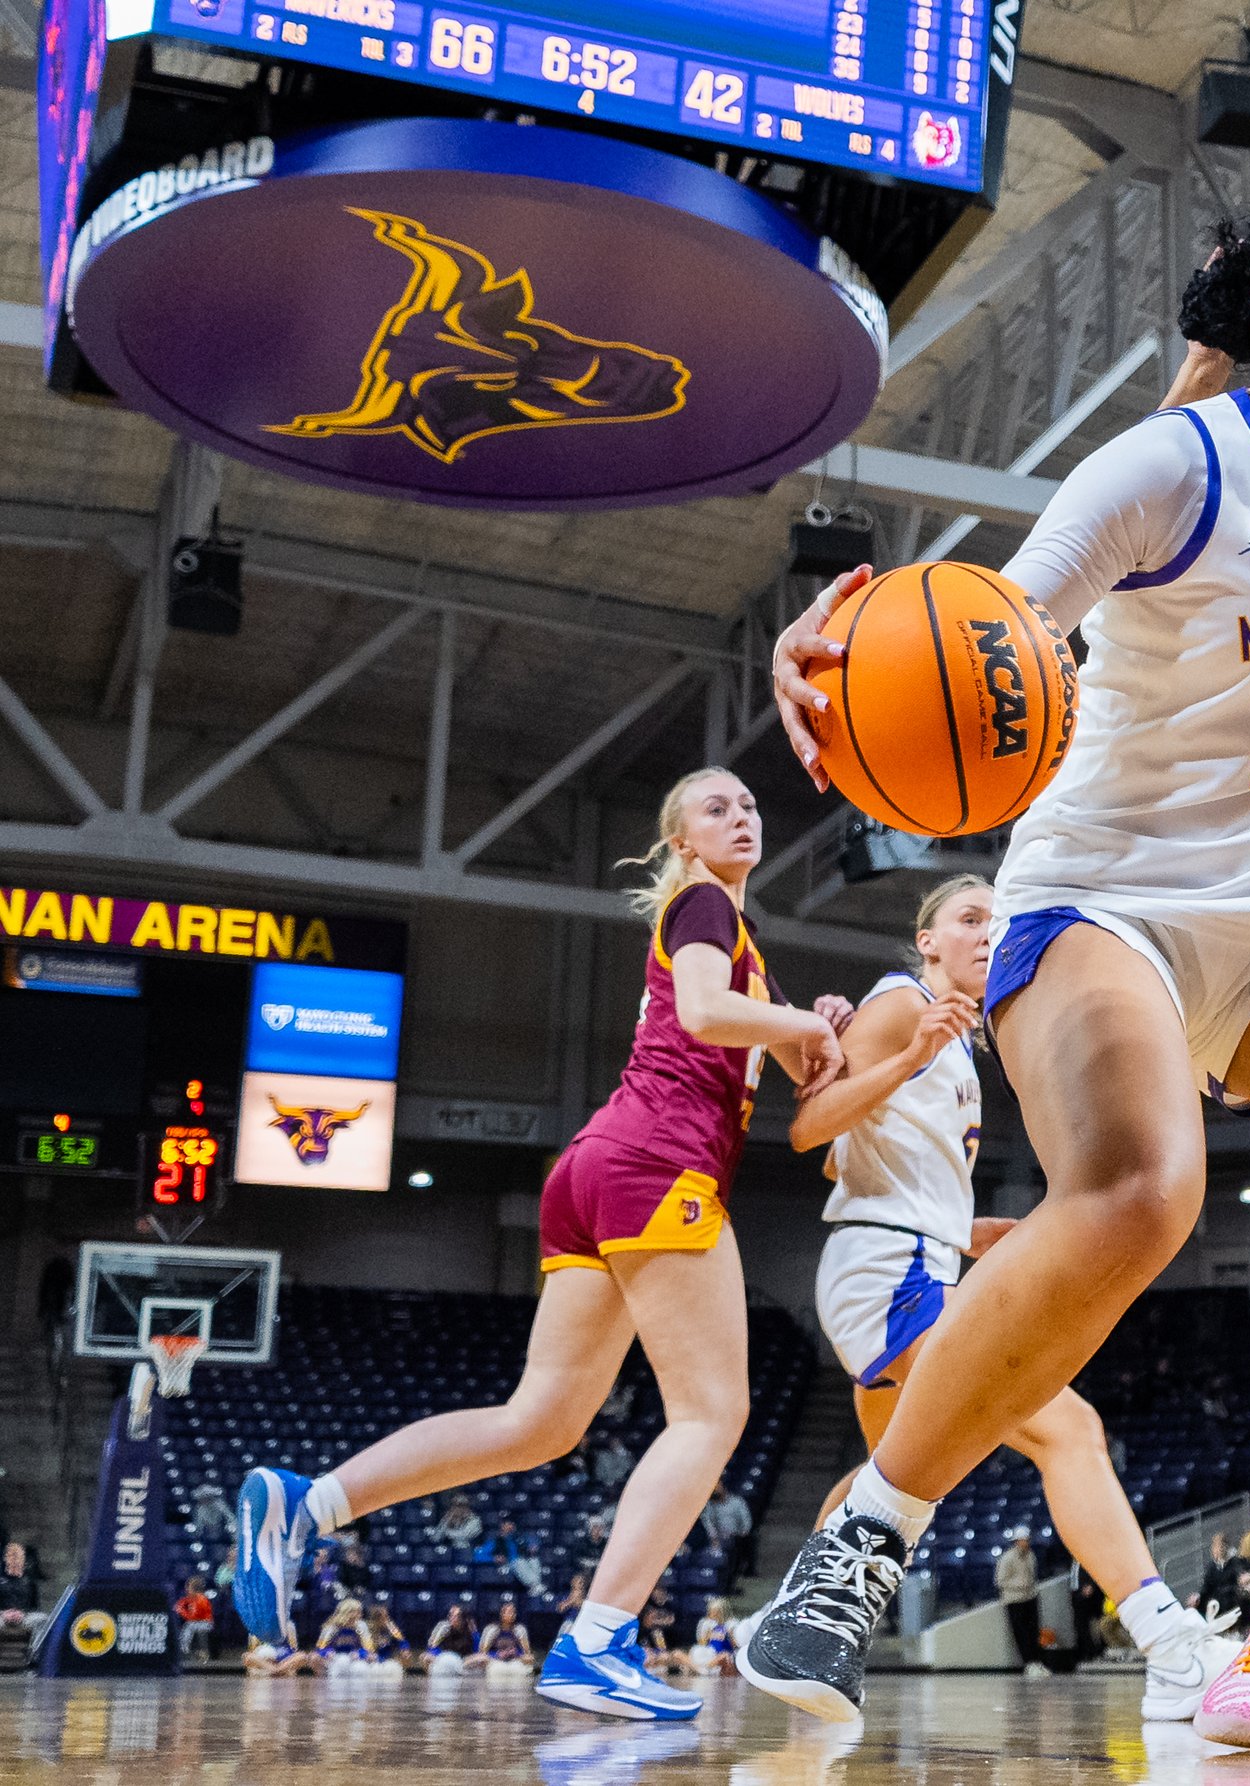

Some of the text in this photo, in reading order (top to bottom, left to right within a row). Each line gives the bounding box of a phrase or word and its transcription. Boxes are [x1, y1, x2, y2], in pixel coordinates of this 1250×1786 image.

[255, 14, 275, 41] 2
[429, 17, 495, 76] 66
[395, 42, 414, 68] 3
[541, 36, 638, 97] 6:52
[577, 90, 595, 115] 4
[684, 69, 744, 125] 42
[794, 83, 865, 126] WOLVES
[755, 112, 774, 139] 2
[880, 139, 896, 162] 4
[956, 620, 990, 761] OFFICIAL GAME BALL
[969, 619, 1029, 760] NCAA
[130, 901, 335, 961] ARENA
[161, 1137, 218, 1166] 6:52
[153, 1161, 207, 1204] 21
[111, 1466, 151, 1571] UNRL
[117, 1641, 166, 1654] WINGS
[118, 1625, 168, 1642] WILD
